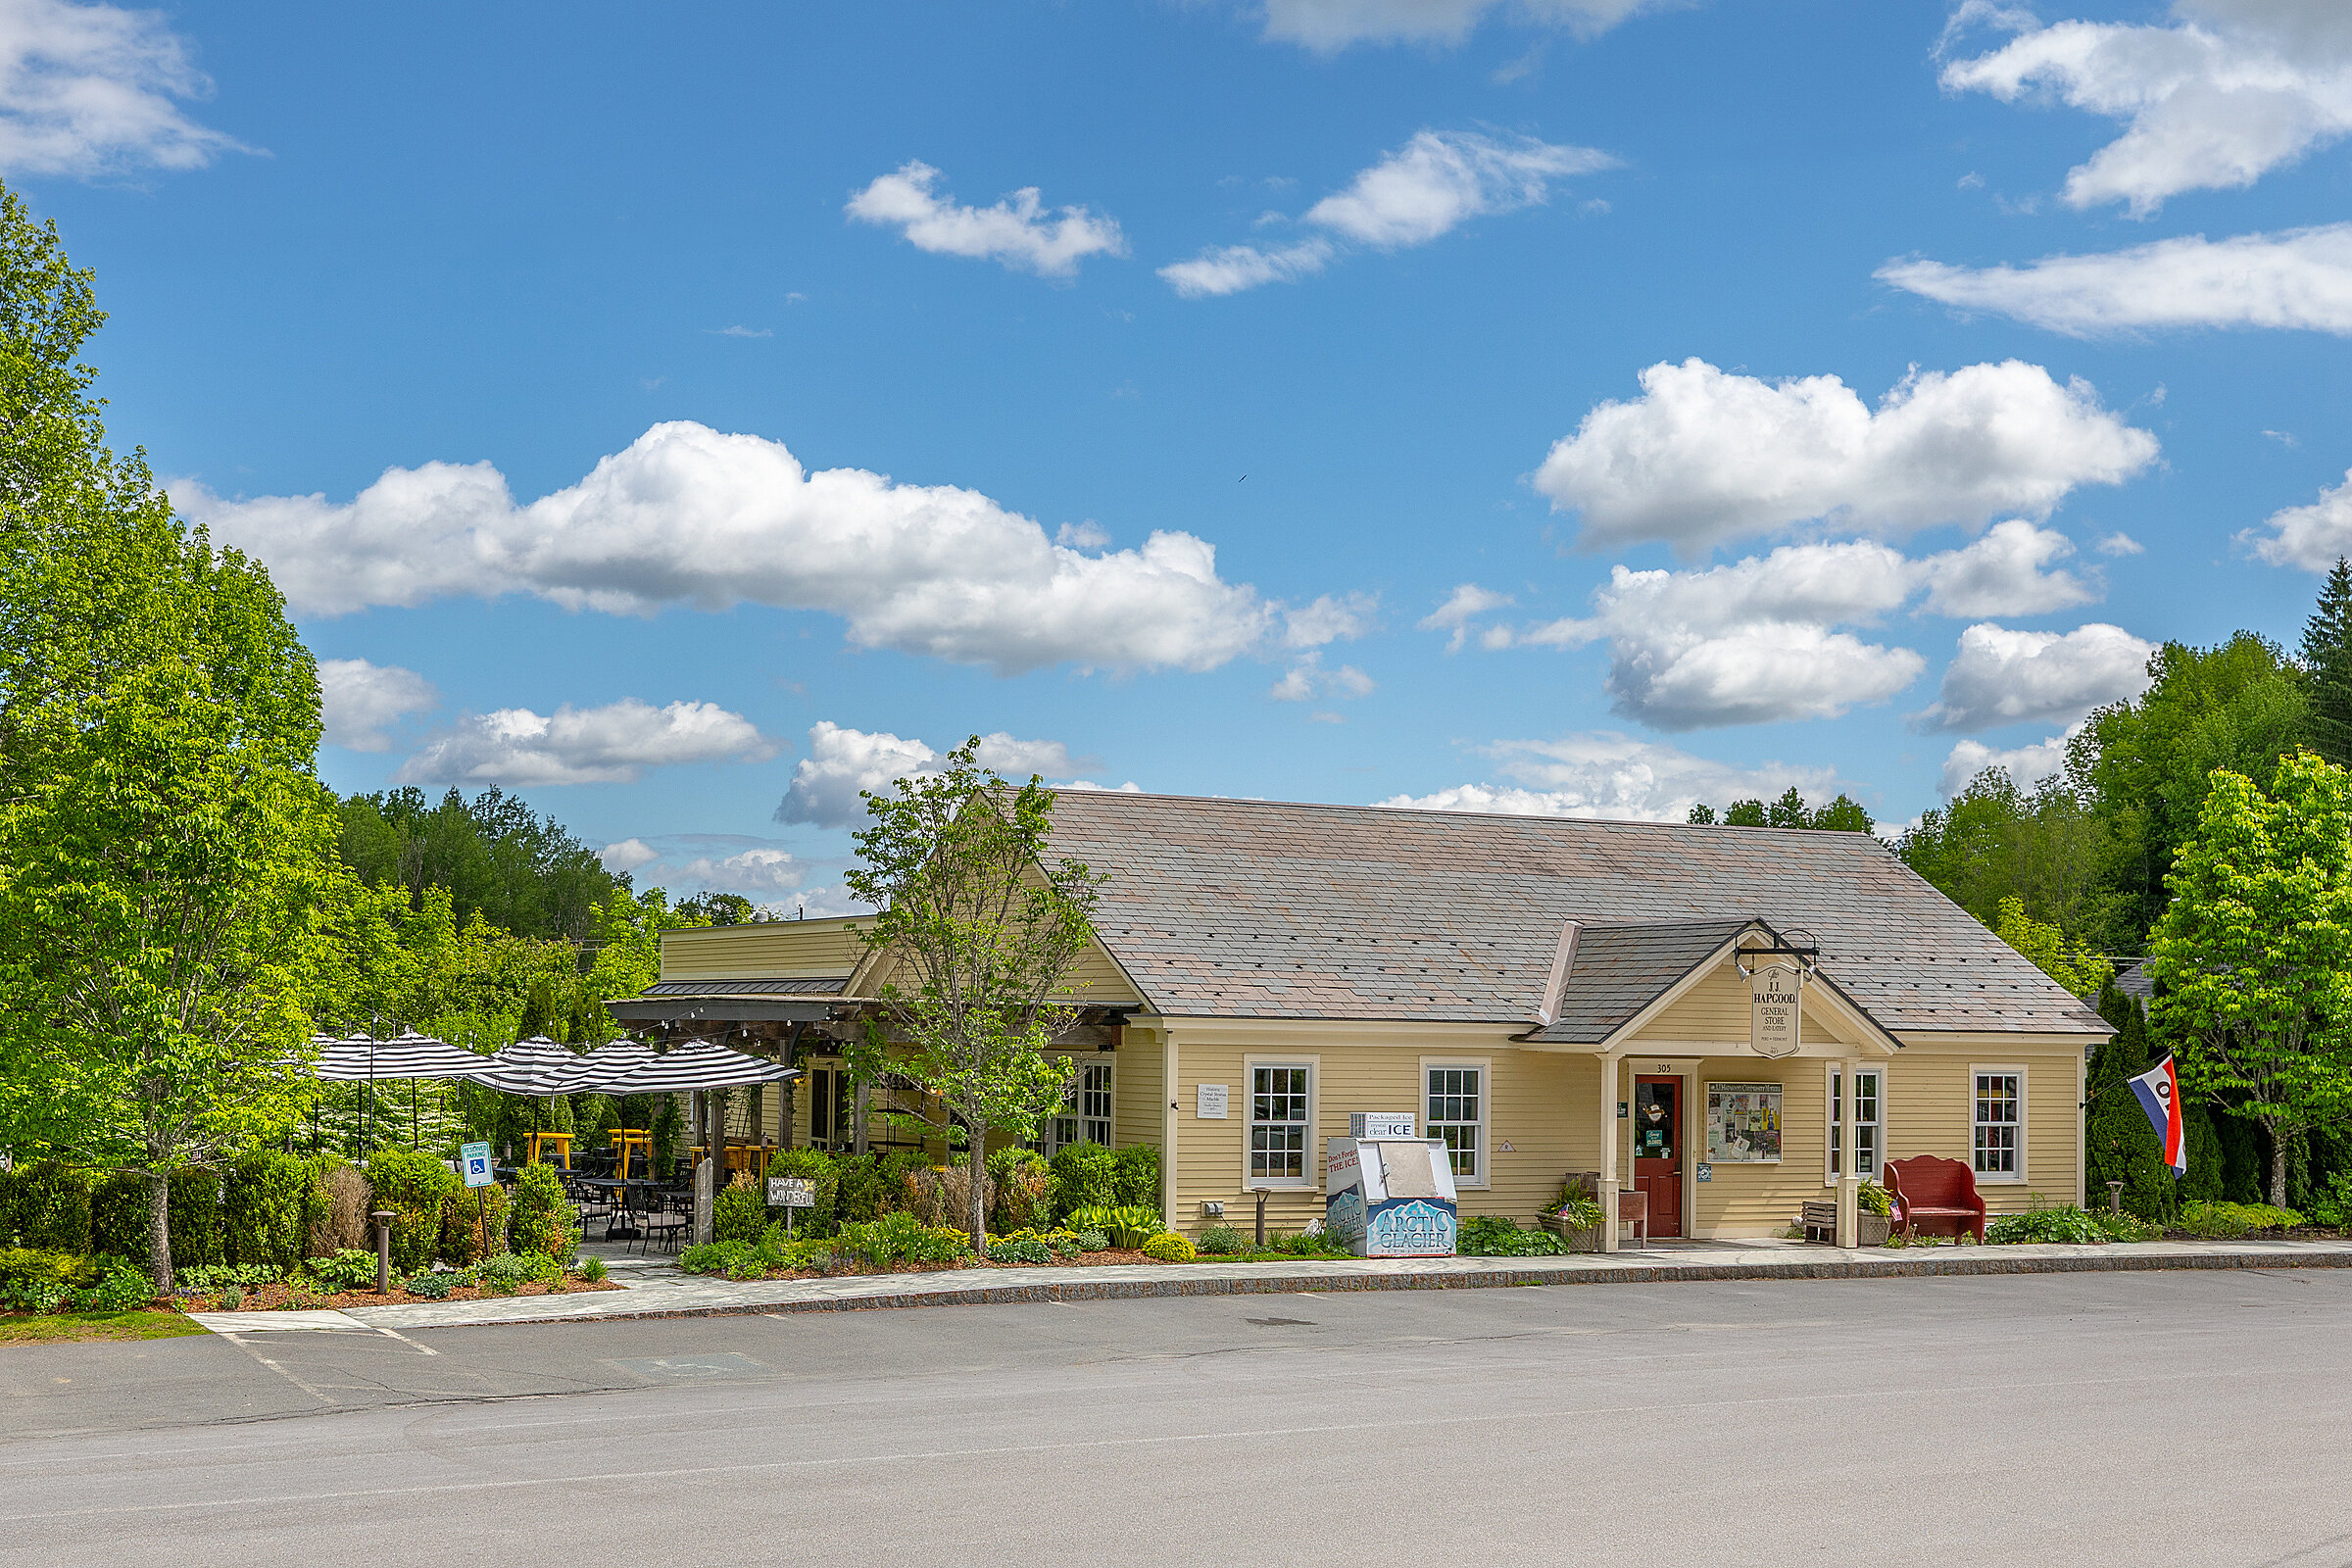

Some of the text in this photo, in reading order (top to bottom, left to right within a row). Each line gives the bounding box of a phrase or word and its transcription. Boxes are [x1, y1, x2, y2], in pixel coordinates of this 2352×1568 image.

[1769, 982, 1781, 992] J.J.
[1761, 1006, 1788, 1016] GENERAL
[1765, 1016, 1785, 1025] STORE
[1657, 1064, 1671, 1073] 305
[1388, 1124, 1411, 1135] ICE
[1328, 1149, 1357, 1163] Don't Forget
[1329, 1156, 1359, 1173] THE ICE!
[770, 1178, 804, 1188] HAVE A
[769, 1190, 815, 1205] WONDERFUL
[1379, 1210, 1448, 1232] ARCTIC
[1380, 1232, 1447, 1248] GLACIER
